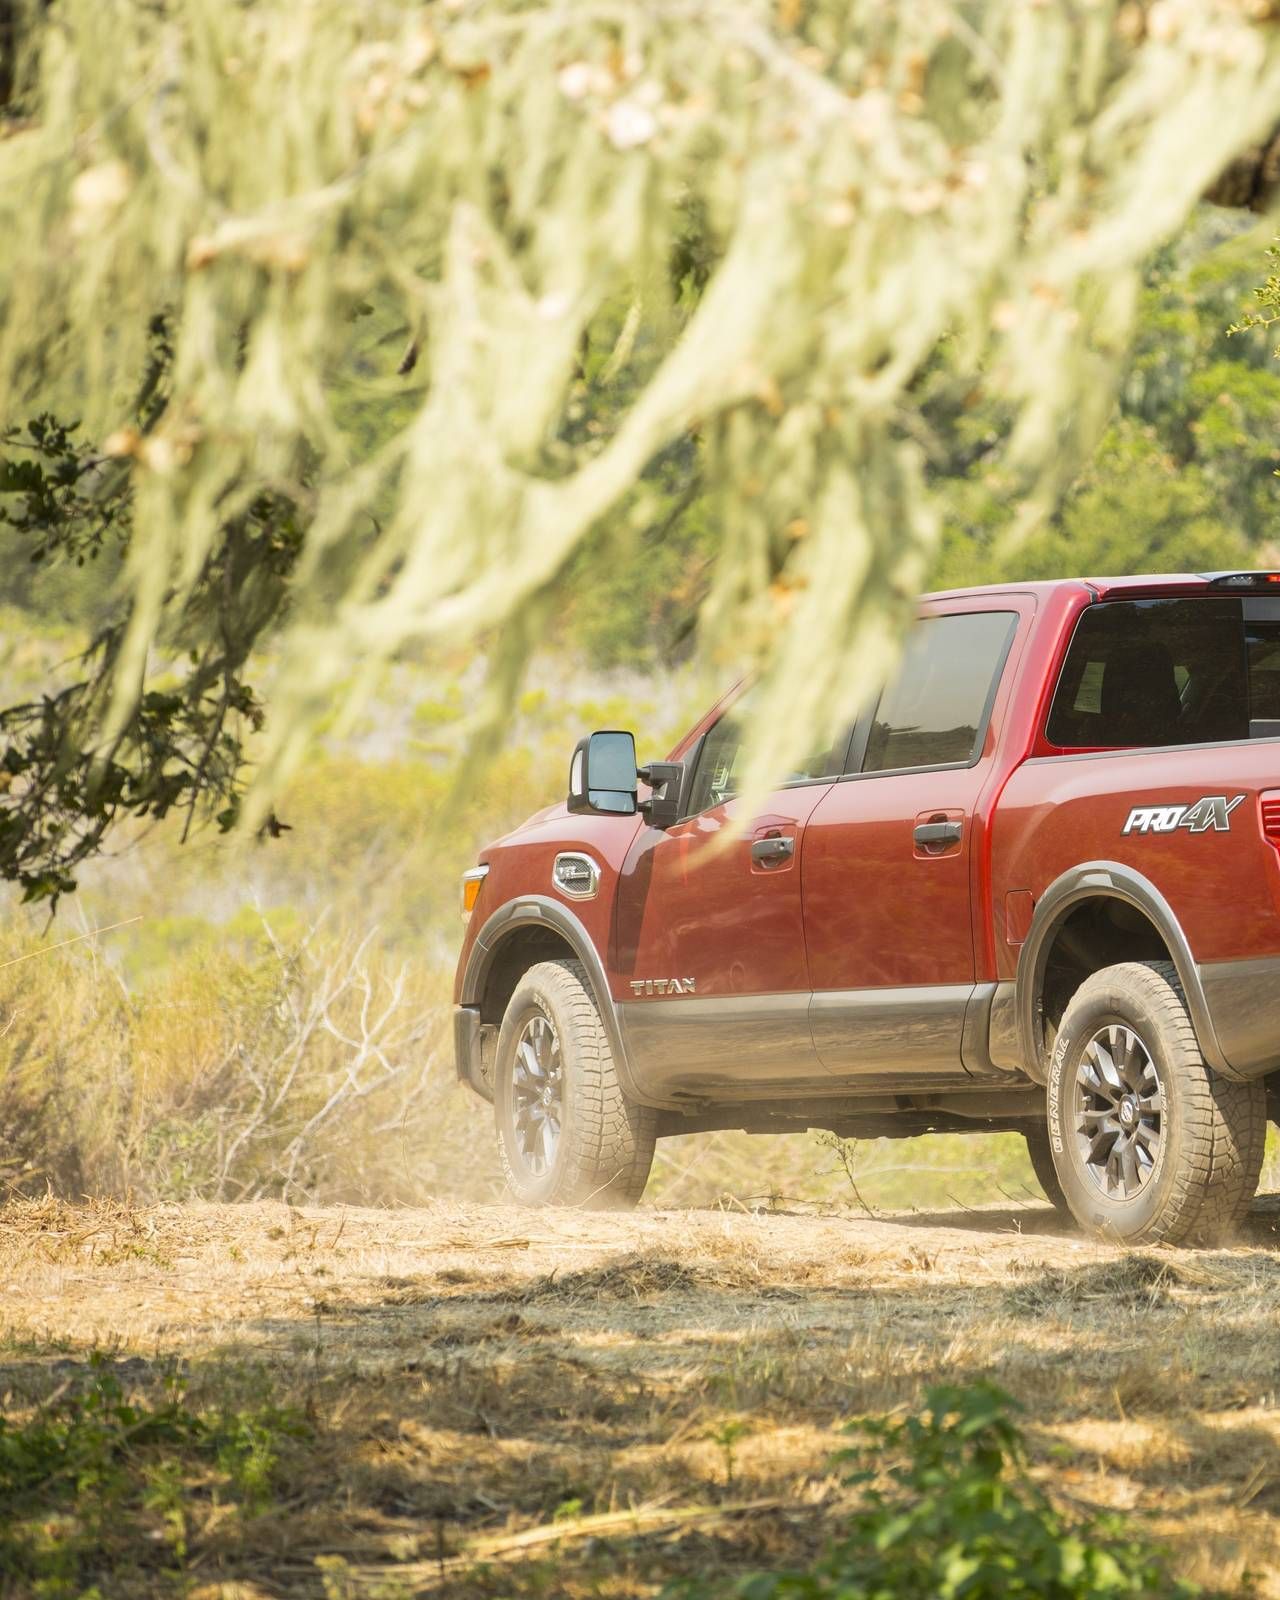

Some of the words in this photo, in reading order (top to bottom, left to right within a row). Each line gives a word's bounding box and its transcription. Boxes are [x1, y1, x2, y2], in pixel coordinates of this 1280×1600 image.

[1121, 793, 1247, 834] PRO4X
[629, 977, 696, 996] TITAN
[1049, 1038, 1070, 1153] GENERAL
